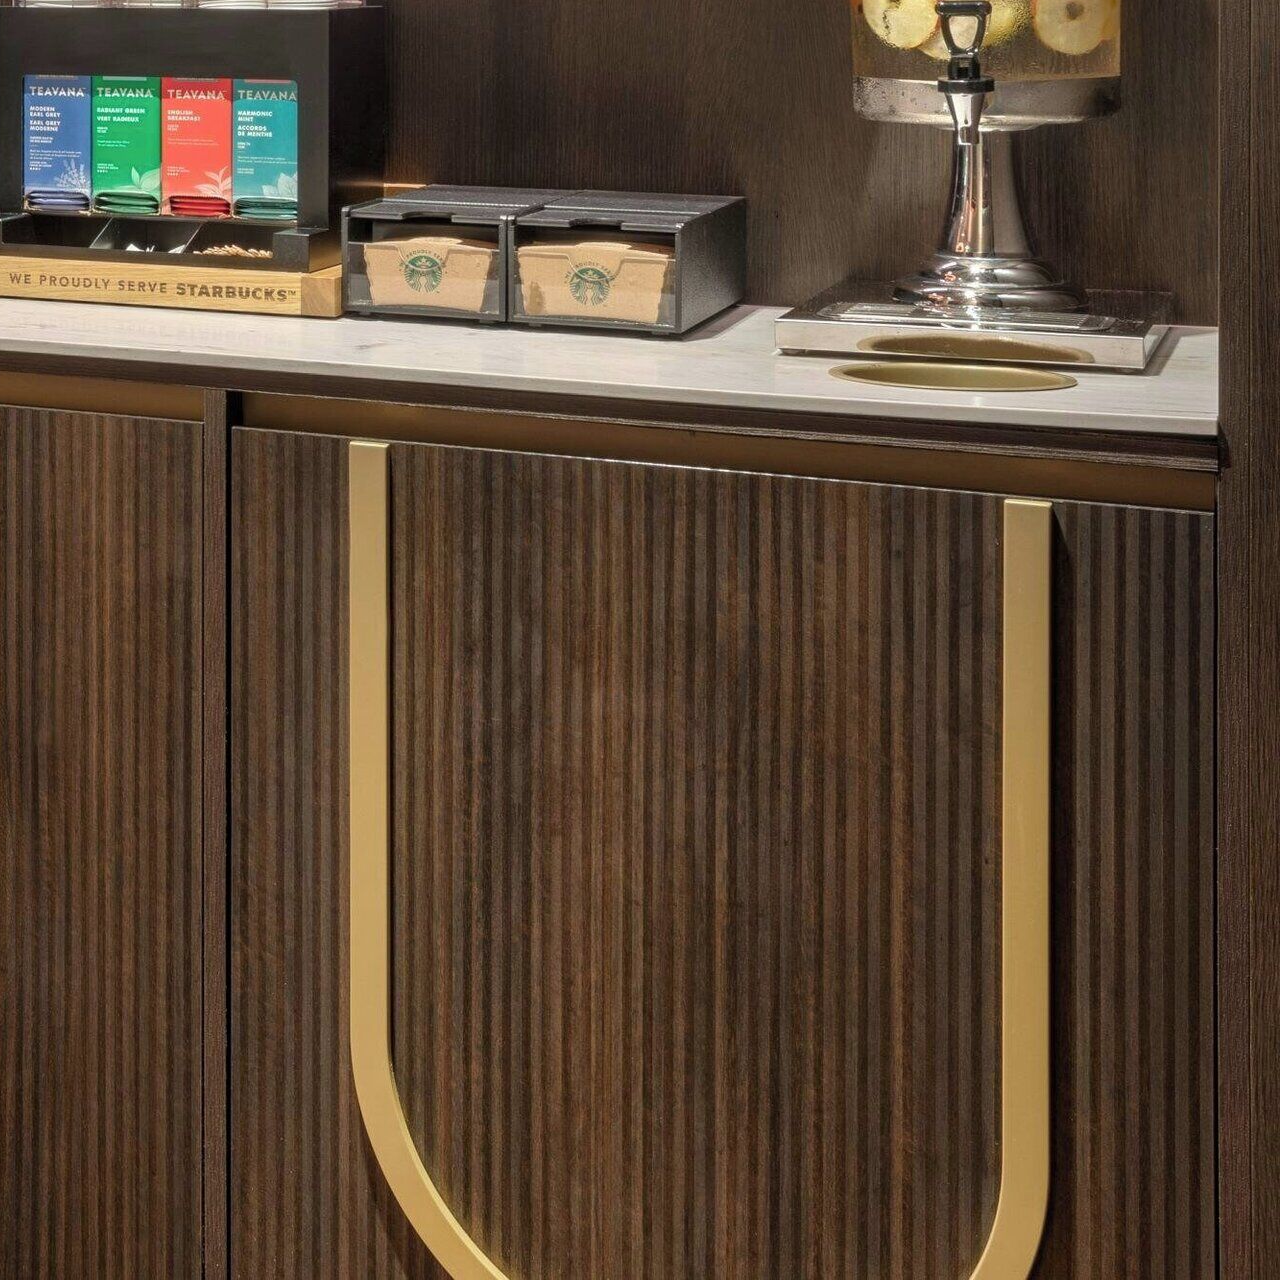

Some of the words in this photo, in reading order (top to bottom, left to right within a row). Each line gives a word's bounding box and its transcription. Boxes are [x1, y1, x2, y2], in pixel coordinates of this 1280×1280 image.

[29, 86, 85, 97] TEAVANA
[97, 87, 154, 98] TEAVANA
[167, 89, 225, 100] TEAVANA
[237, 90, 297, 101] TEAVANA
[9, 272, 32, 284] WE
[39, 274, 111, 290] PROUDLY
[118, 279, 168, 293] SERVE
